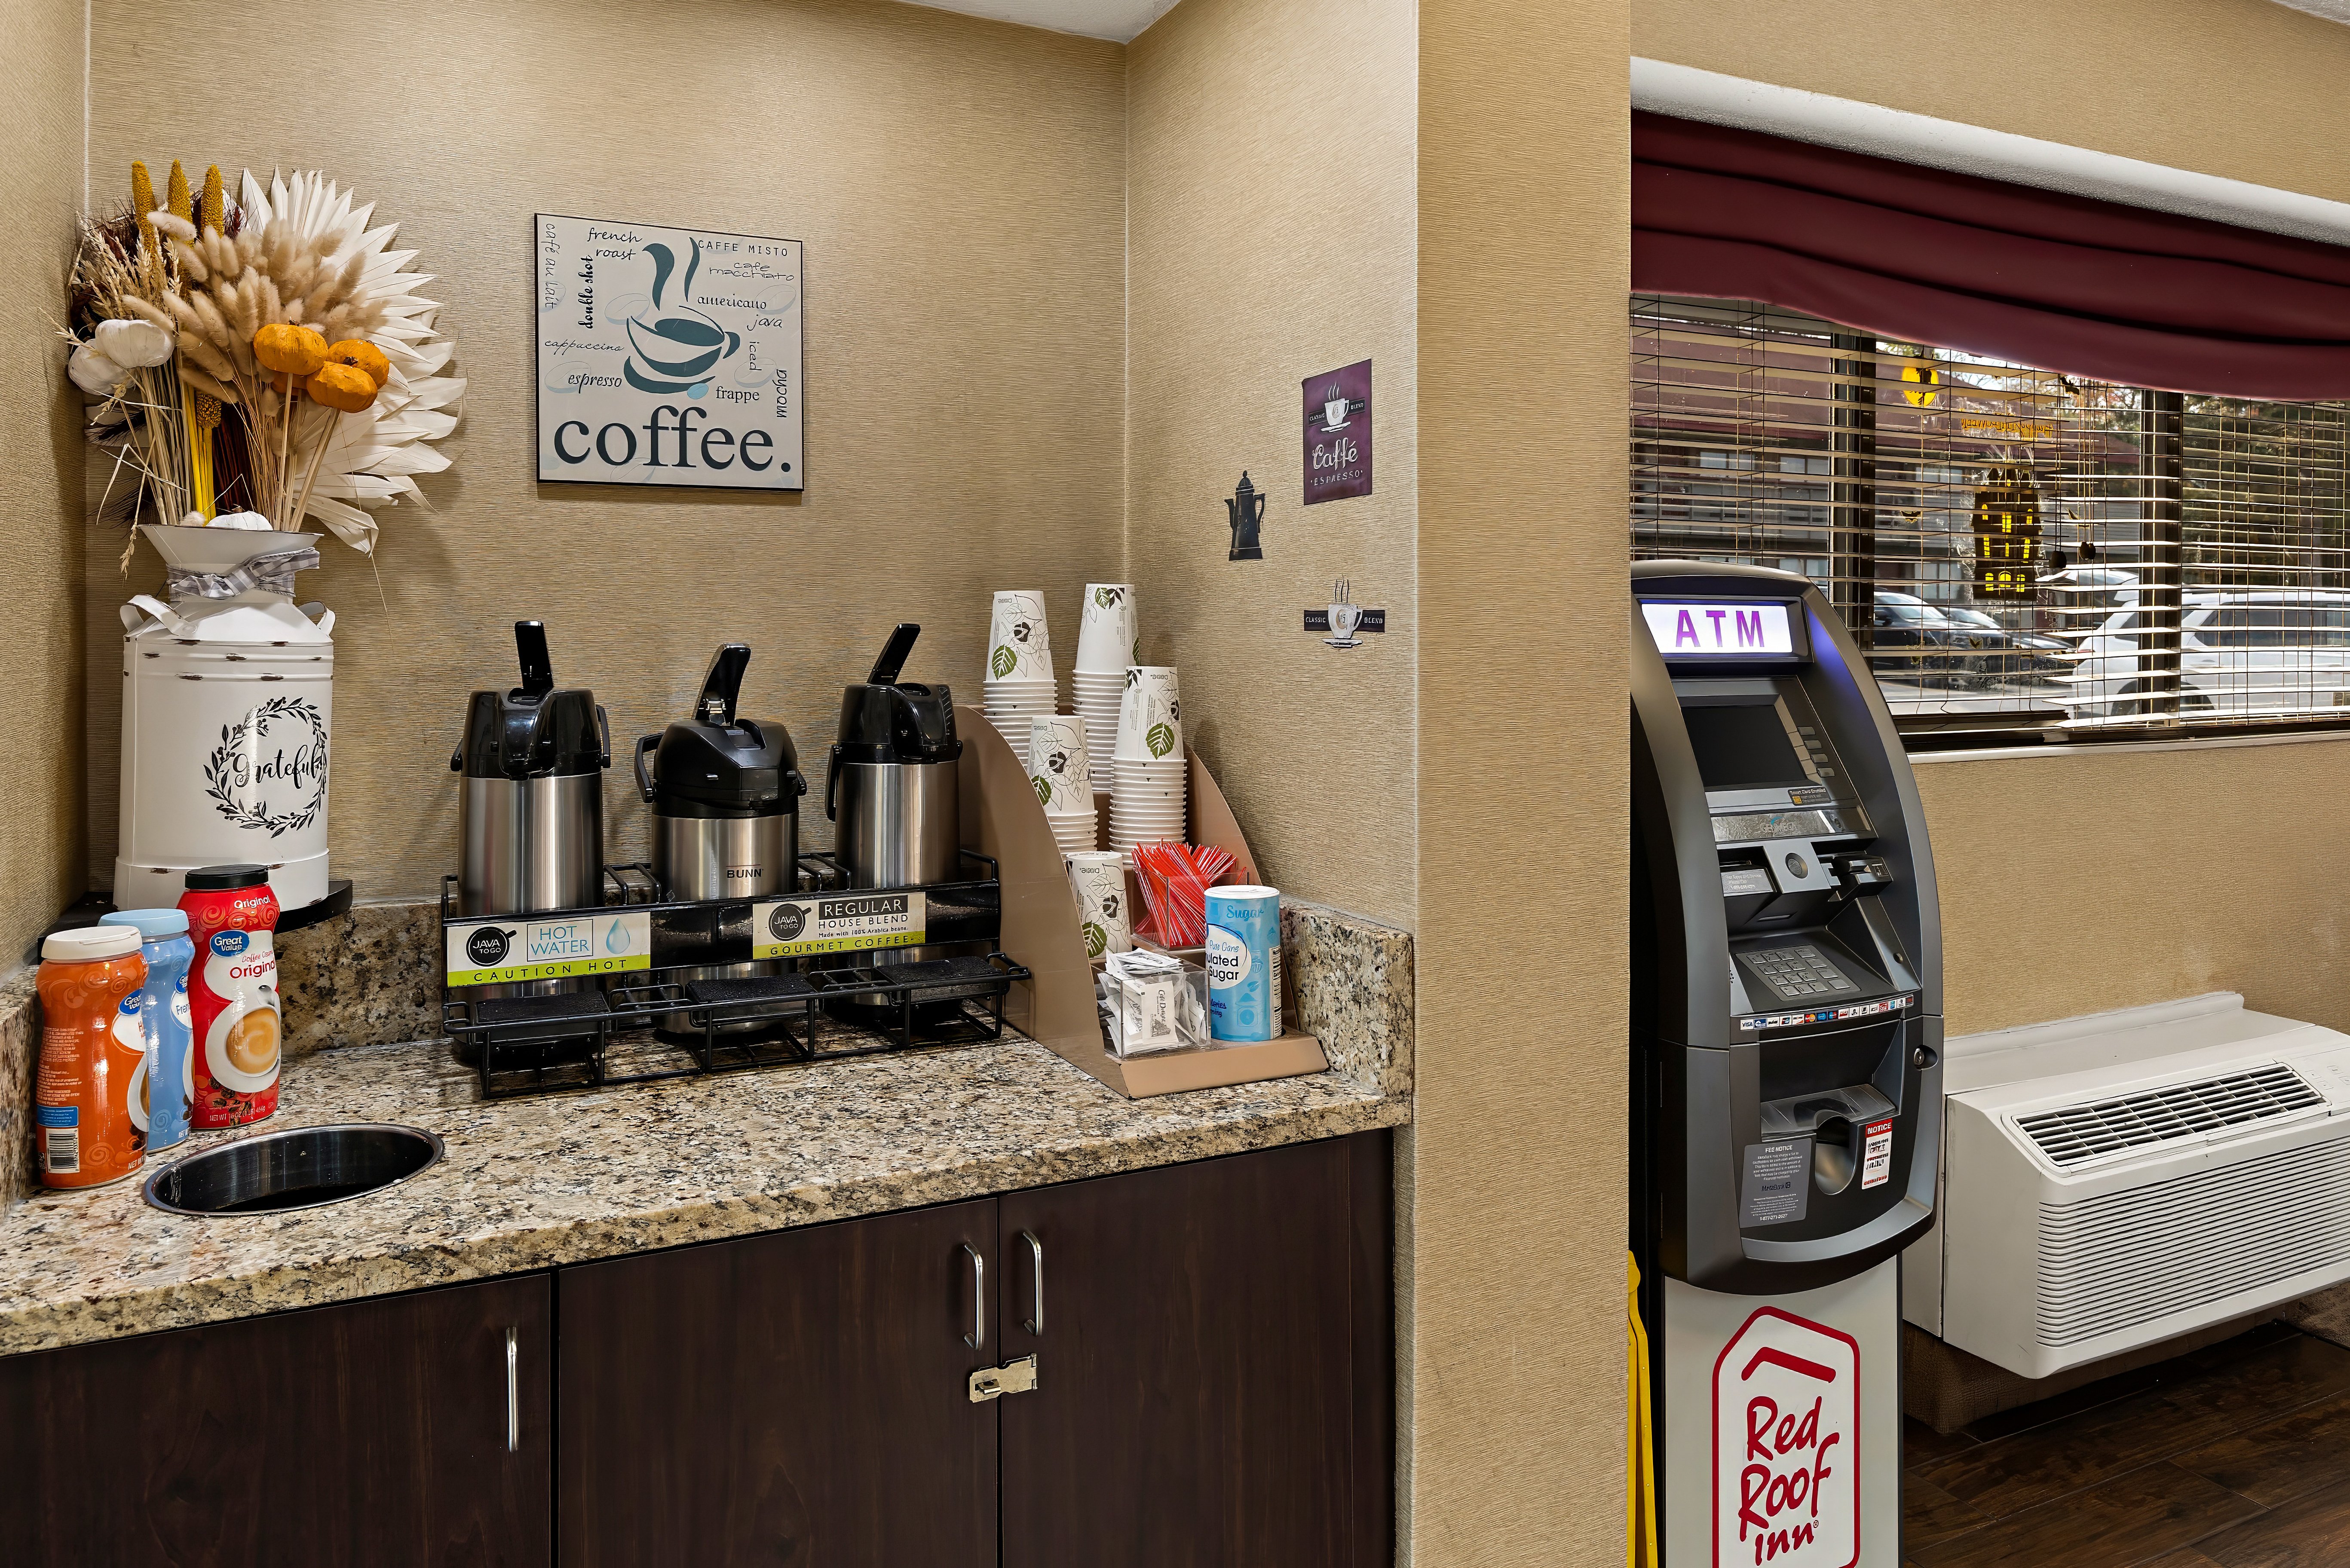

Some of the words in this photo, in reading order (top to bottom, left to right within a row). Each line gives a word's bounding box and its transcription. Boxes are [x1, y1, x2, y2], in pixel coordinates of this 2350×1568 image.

[588, 227, 642, 242] french
[596, 247, 636, 260] roast
[698, 240, 738, 252] CAFFE
[748, 245, 788, 257] MISTO
[545, 260, 555, 276] au
[581, 255, 593, 290] shot
[709, 267, 794, 281] macchiato
[734, 262, 769, 272] cafe
[698, 294, 766, 309] americano
[578, 292, 593, 329] double
[747, 314, 783, 331] java
[545, 340, 624, 355] cappuccino
[749, 341, 762, 372] iced
[568, 373, 622, 394] espresso
[716, 386, 760, 403] frappe
[772, 369, 787, 418] mocha
[554, 405, 791, 473] coffee.
[1312, 438, 1358, 470] Caffé
[1676, 610, 1765, 647] ATM
[233, 743, 322, 789] Grateful
[727, 869, 761, 878] BUNN
[234, 895, 270, 909] Original
[825, 899, 902, 917] REGULAR
[774, 916, 797, 925] JAVA
[1226, 905, 1264, 922] Sugar
[818, 918, 861, 929] HOUSE
[869, 915, 908, 925] BLEND
[540, 925, 577, 940] HOT
[214, 936, 242, 946] Great
[473, 939, 500, 949] JAVA
[530, 940, 589, 956] WATER
[771, 941, 844, 955] GOURMET
[855, 935, 909, 948] COFFEE
[1222, 942, 1239, 952] Cane
[242, 954, 260, 963] Coffee
[1207, 953, 1238, 967] ulated
[474, 965, 571, 982] CAUTION
[589, 959, 627, 971] HOT
[1209, 965, 1239, 982] Sugar
[176, 1003, 190, 1015] Fren
[1868, 1122, 1891, 1134] NOTICE
[1746, 1396, 1822, 1461] Red
[1738, 1432, 1840, 1542] Roof
